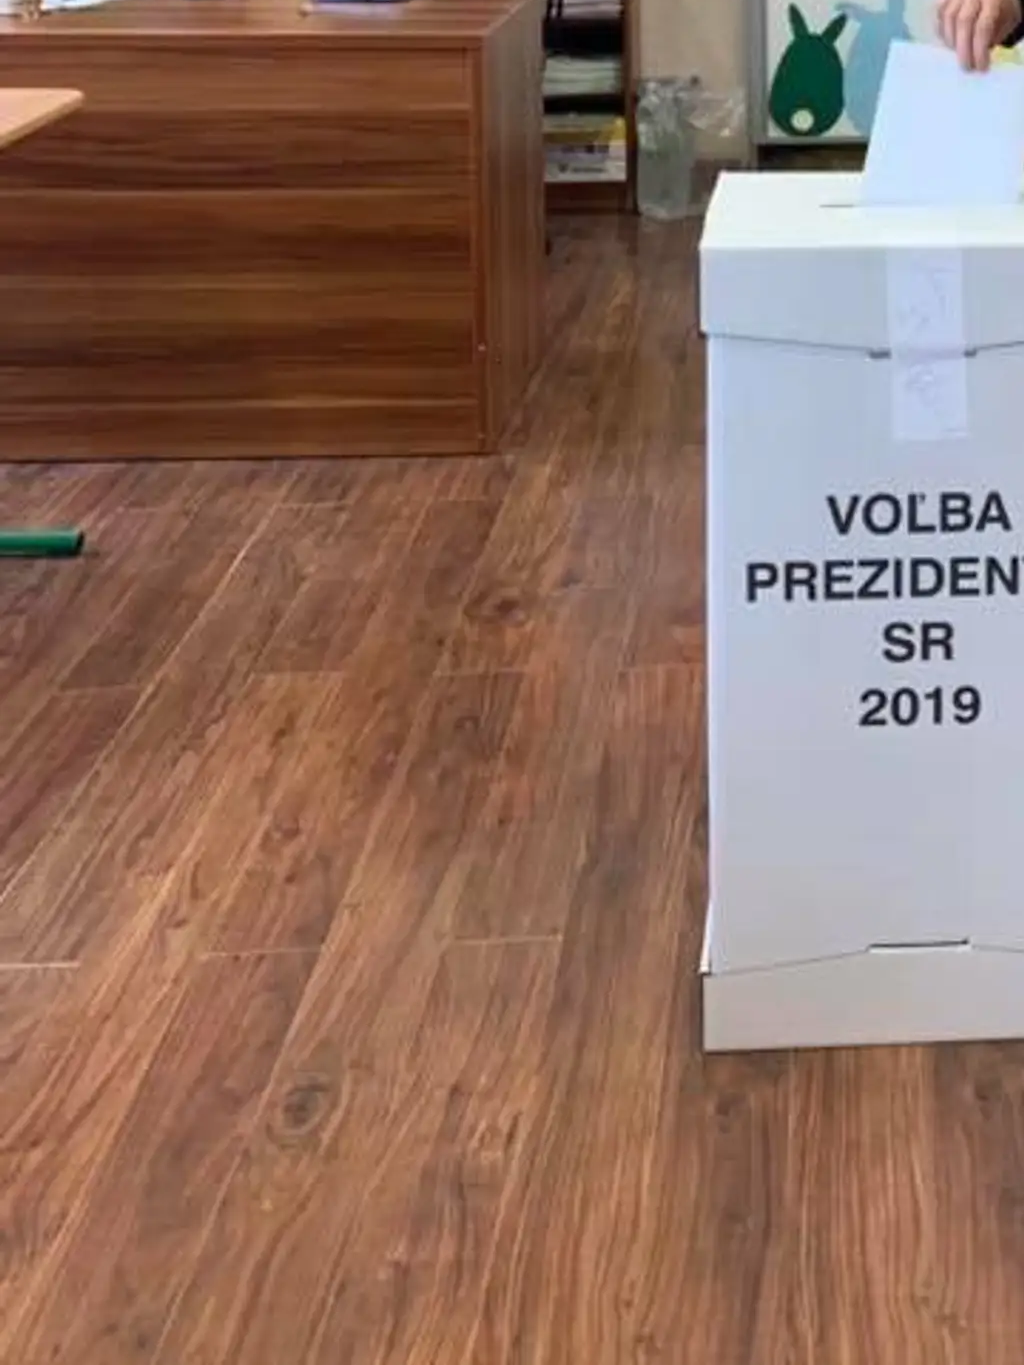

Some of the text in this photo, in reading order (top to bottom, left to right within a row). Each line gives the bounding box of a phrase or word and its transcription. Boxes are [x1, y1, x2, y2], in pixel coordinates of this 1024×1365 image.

[826, 491, 1012, 536] VOĽBA
[882, 621, 954, 663] SR
[858, 685, 982, 726] 2019
